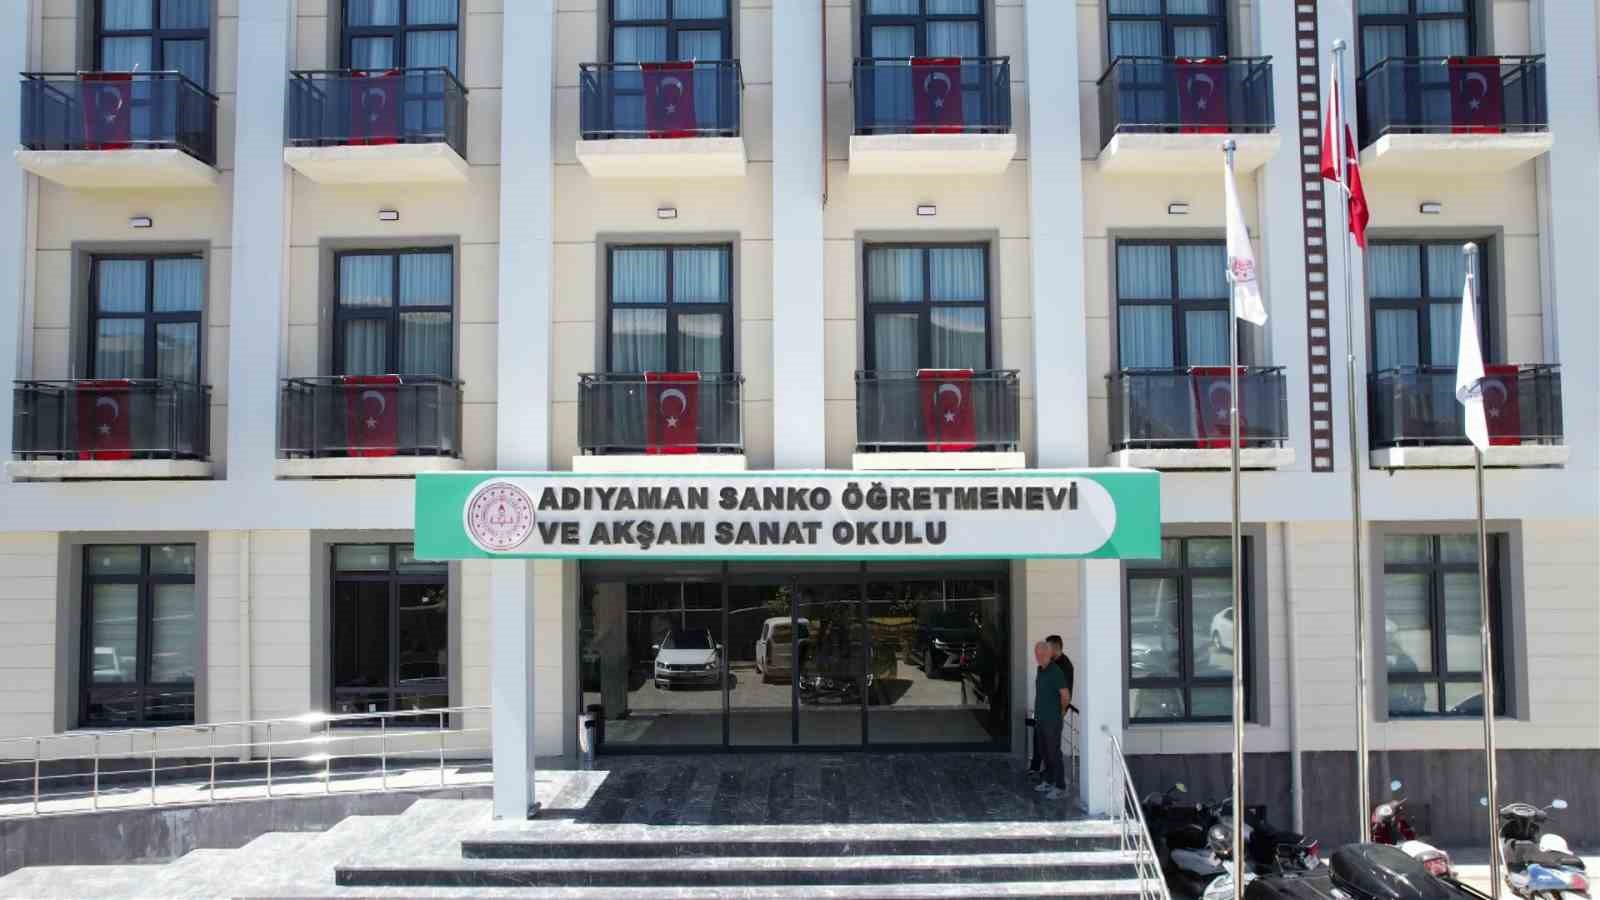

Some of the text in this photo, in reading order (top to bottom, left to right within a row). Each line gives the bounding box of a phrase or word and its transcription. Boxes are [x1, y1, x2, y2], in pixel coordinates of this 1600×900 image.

[538, 482, 1078, 511] ADIYAMAN SANKO ÖĞRETMENEVİ
[537, 520, 947, 550] VE AKŞAM SANAT OKULU
